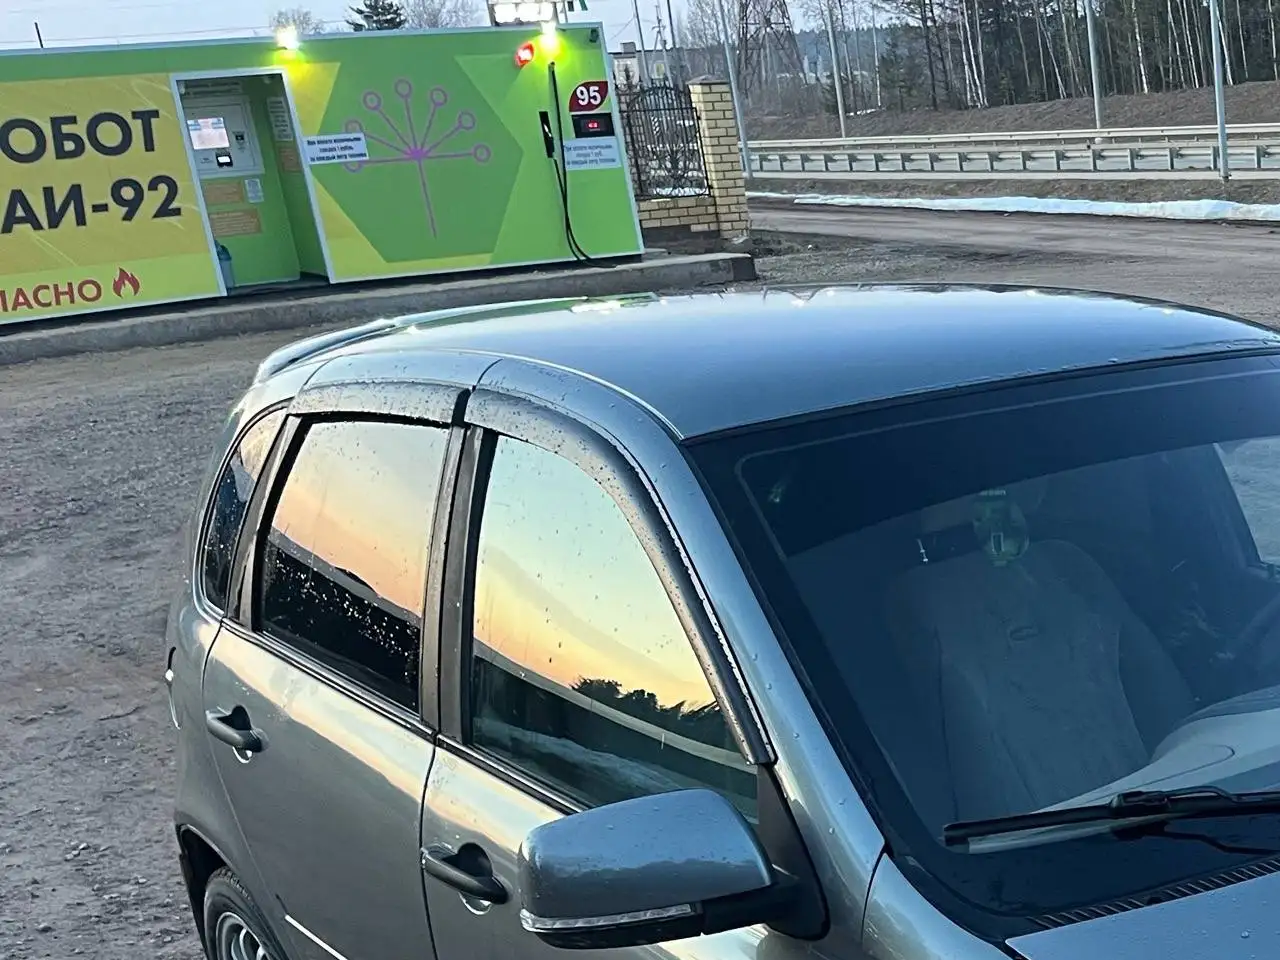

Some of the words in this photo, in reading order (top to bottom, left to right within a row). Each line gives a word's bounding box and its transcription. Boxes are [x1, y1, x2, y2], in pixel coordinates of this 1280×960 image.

[576, 85, 601, 106] 95
[0, 109, 160, 164] ОБОТ
[0, 174, 182, 234] АИ-92
